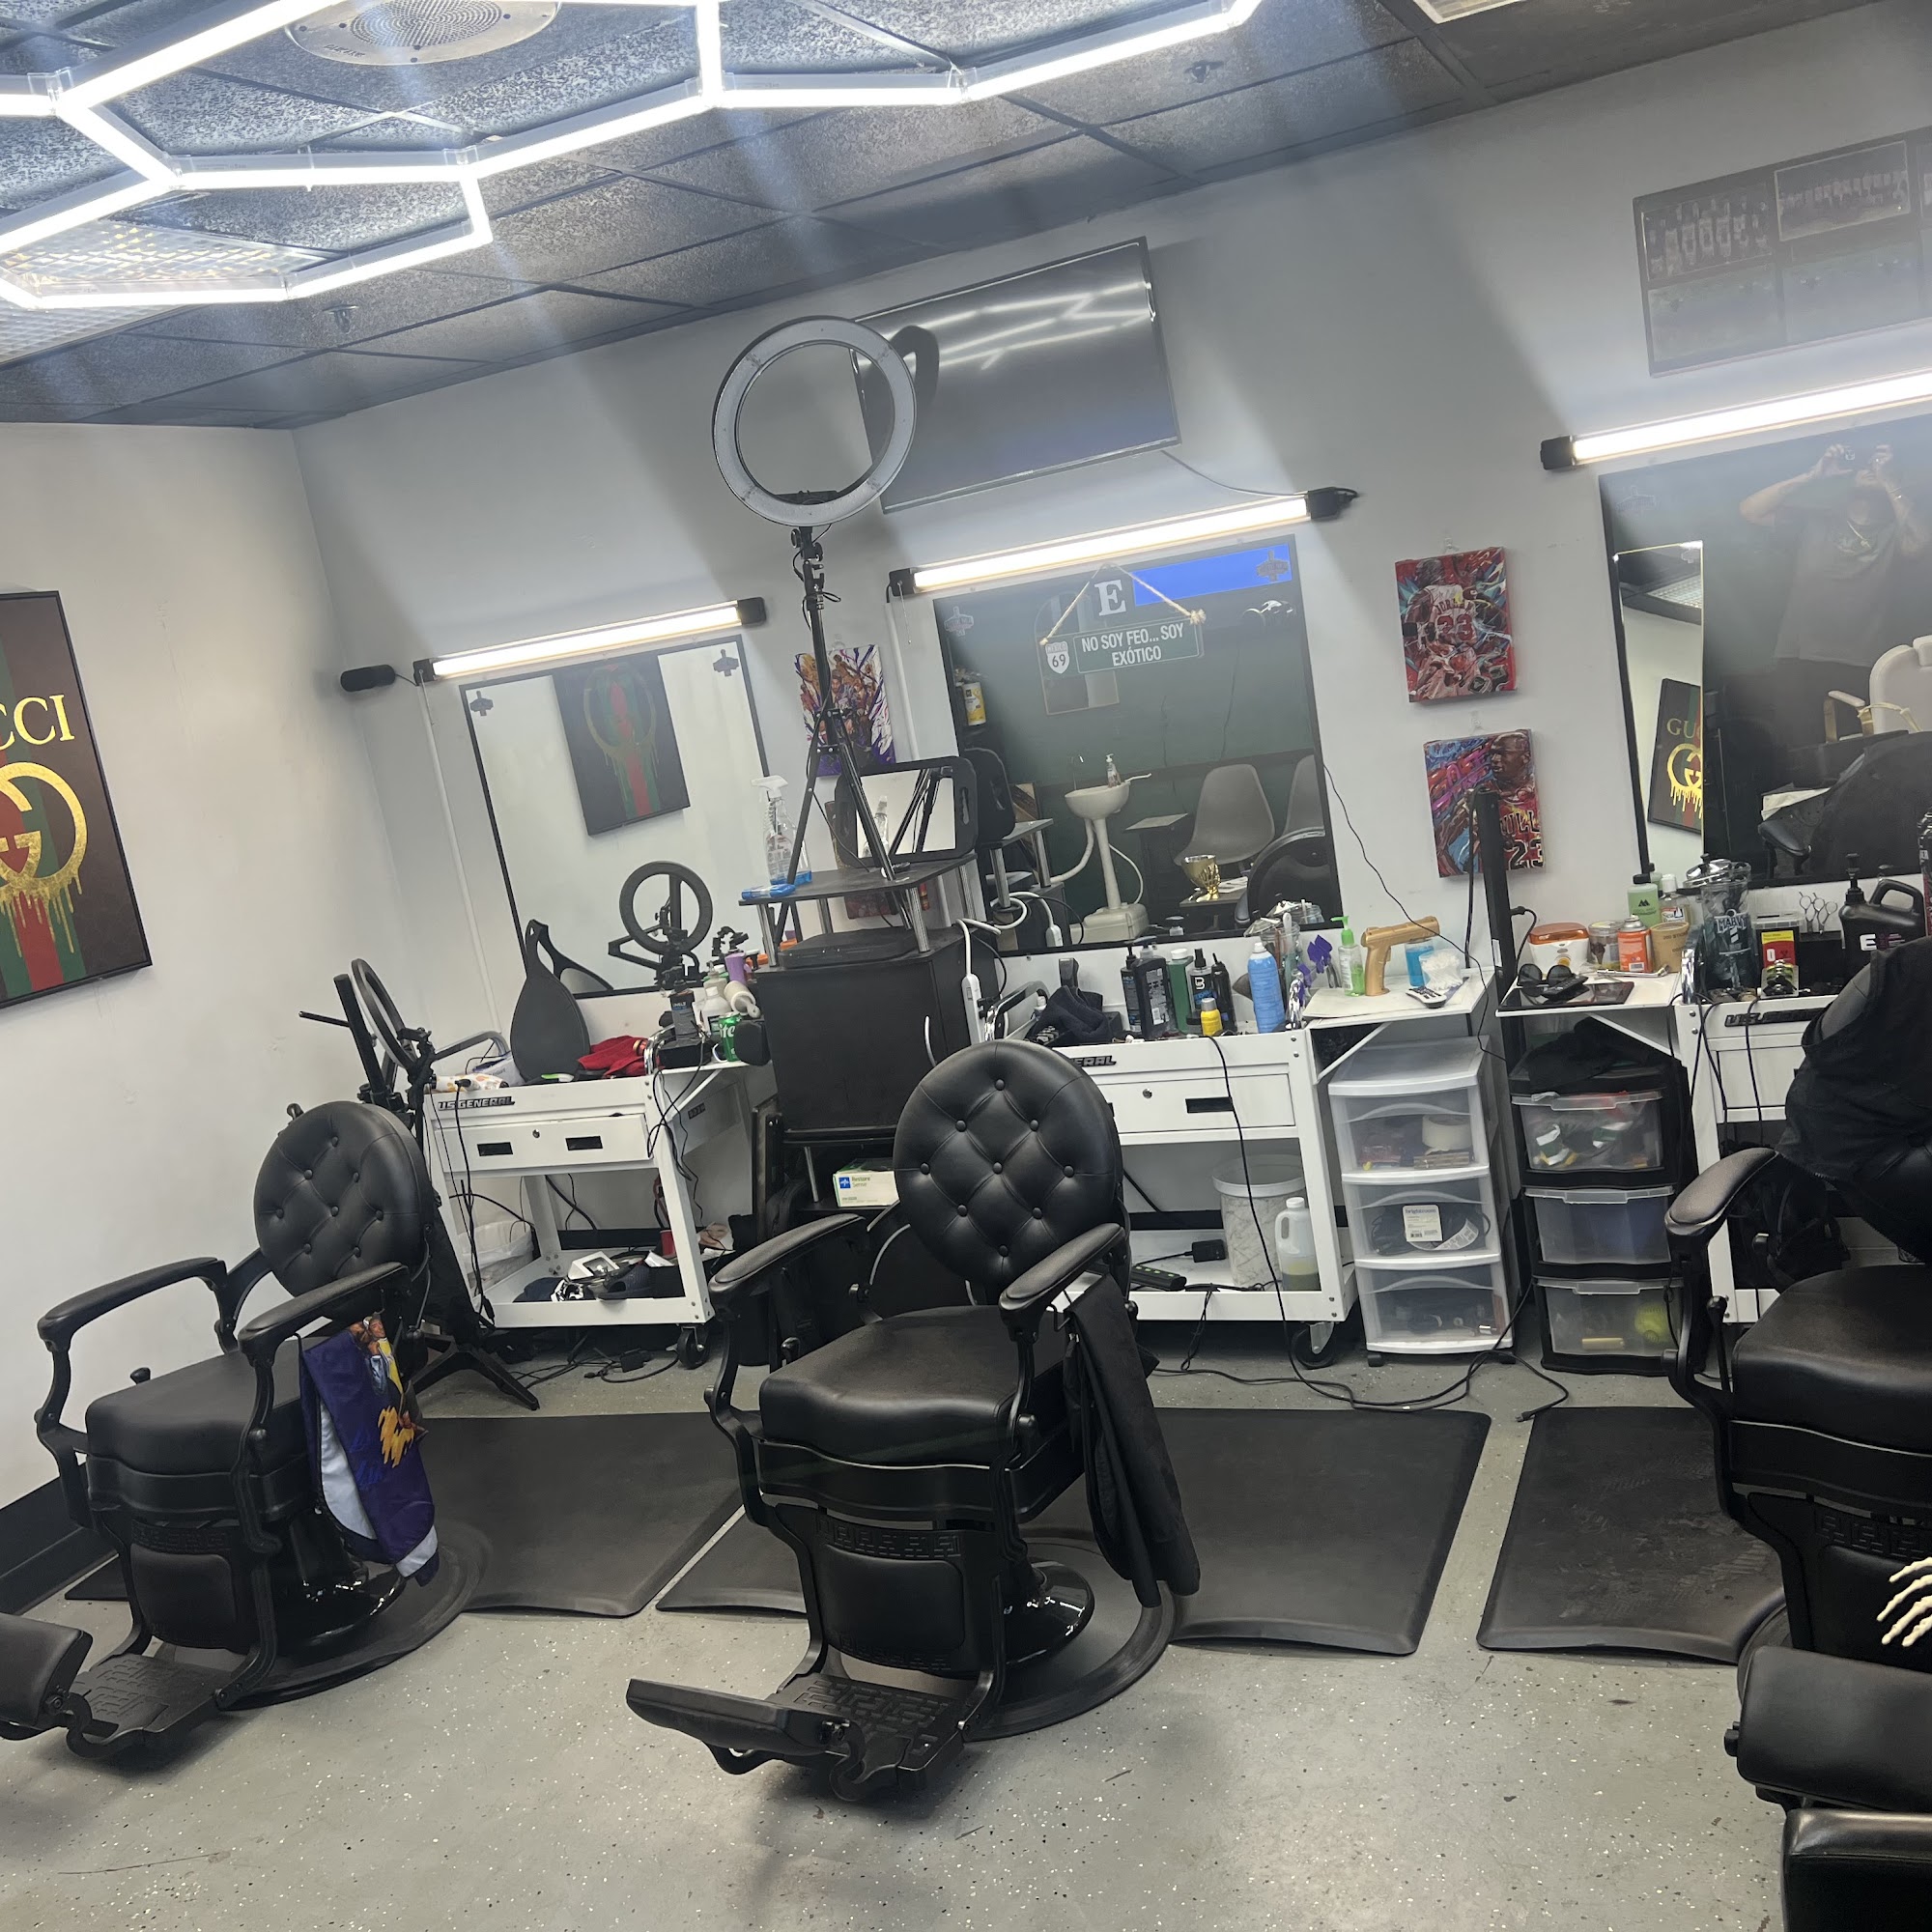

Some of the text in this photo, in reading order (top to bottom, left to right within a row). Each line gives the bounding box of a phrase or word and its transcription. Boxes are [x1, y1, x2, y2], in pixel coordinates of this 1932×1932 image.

[1094, 580, 1126, 616] E
[1082, 623, 1183, 652] NO SOY FEO... SOY
[1052, 654, 1066, 668] 69
[1112, 645, 1162, 667] EXÓTICO
[719, 1023, 735, 1037] ite
[1071, 1055, 1116, 1066] ERAL
[458, 1096, 514, 1110] GENERAL
